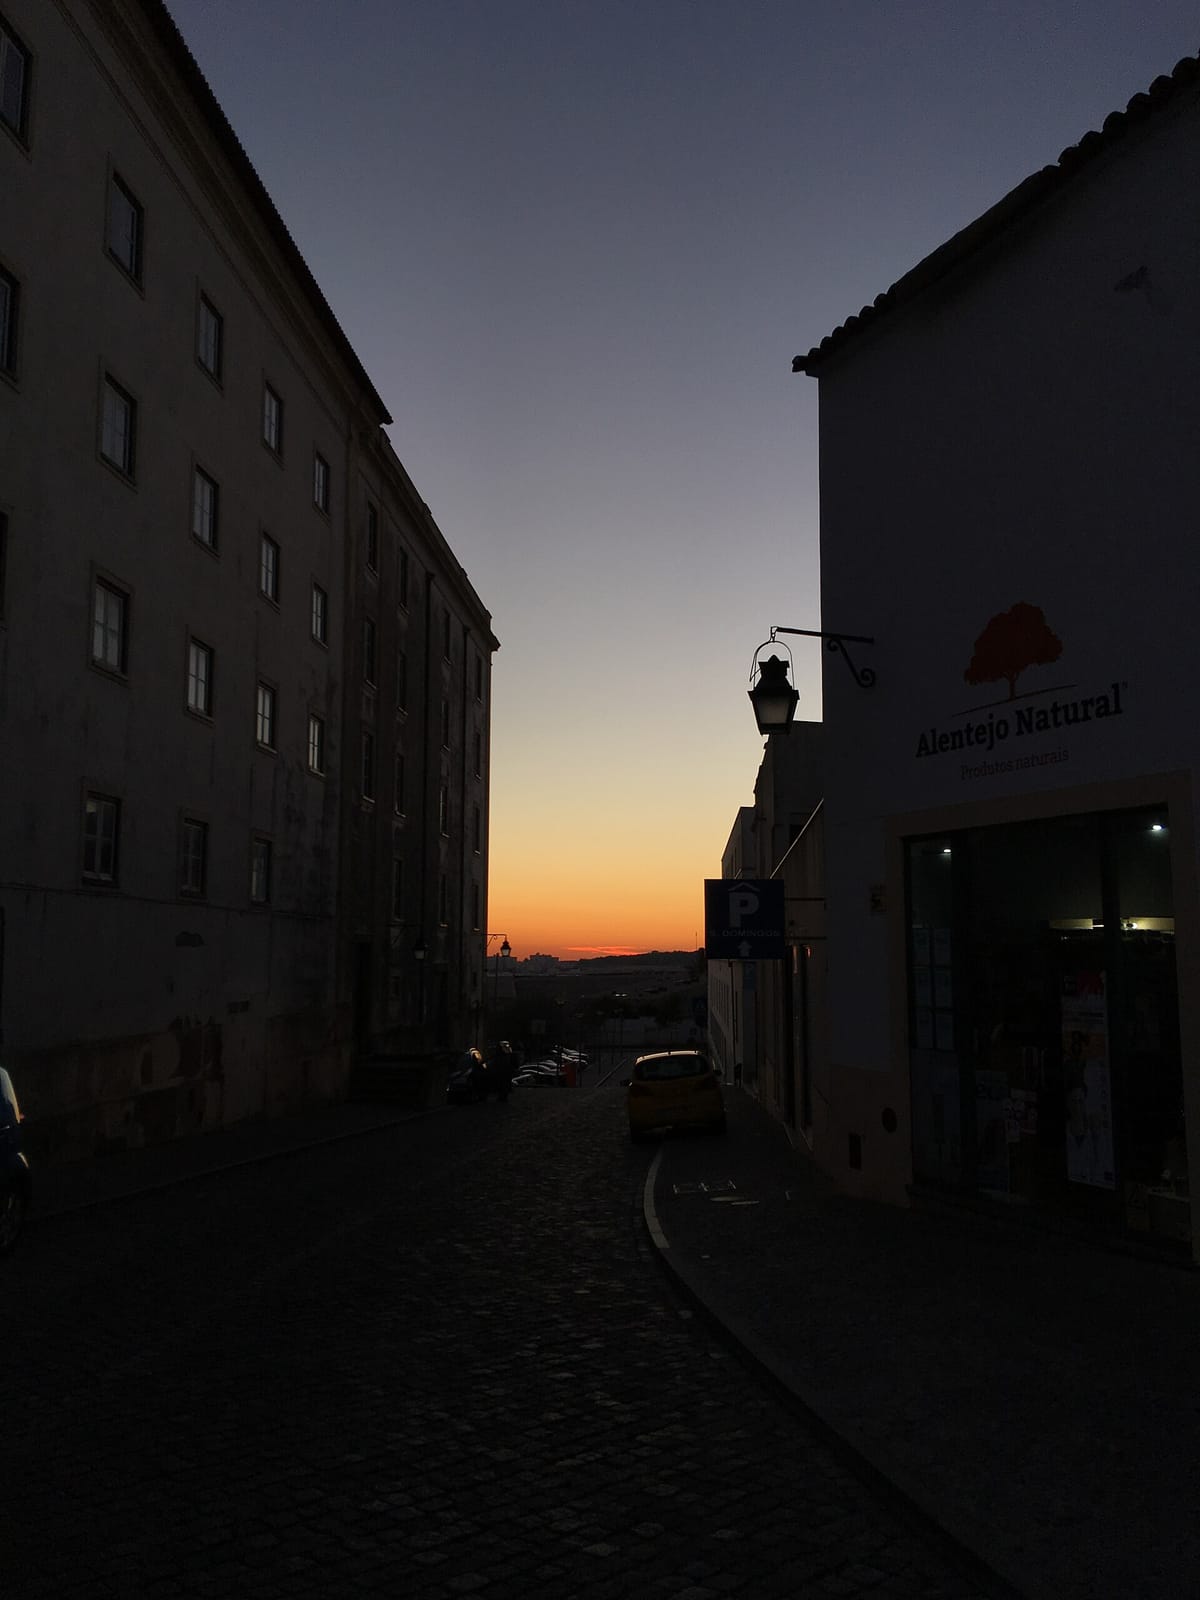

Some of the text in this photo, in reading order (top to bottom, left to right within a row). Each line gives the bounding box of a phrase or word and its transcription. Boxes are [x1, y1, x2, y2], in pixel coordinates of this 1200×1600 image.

[915, 683, 1123, 757] Alentejo Natural
[960, 747, 1070, 781] Produtos naturais
[729, 893, 759, 927] P
